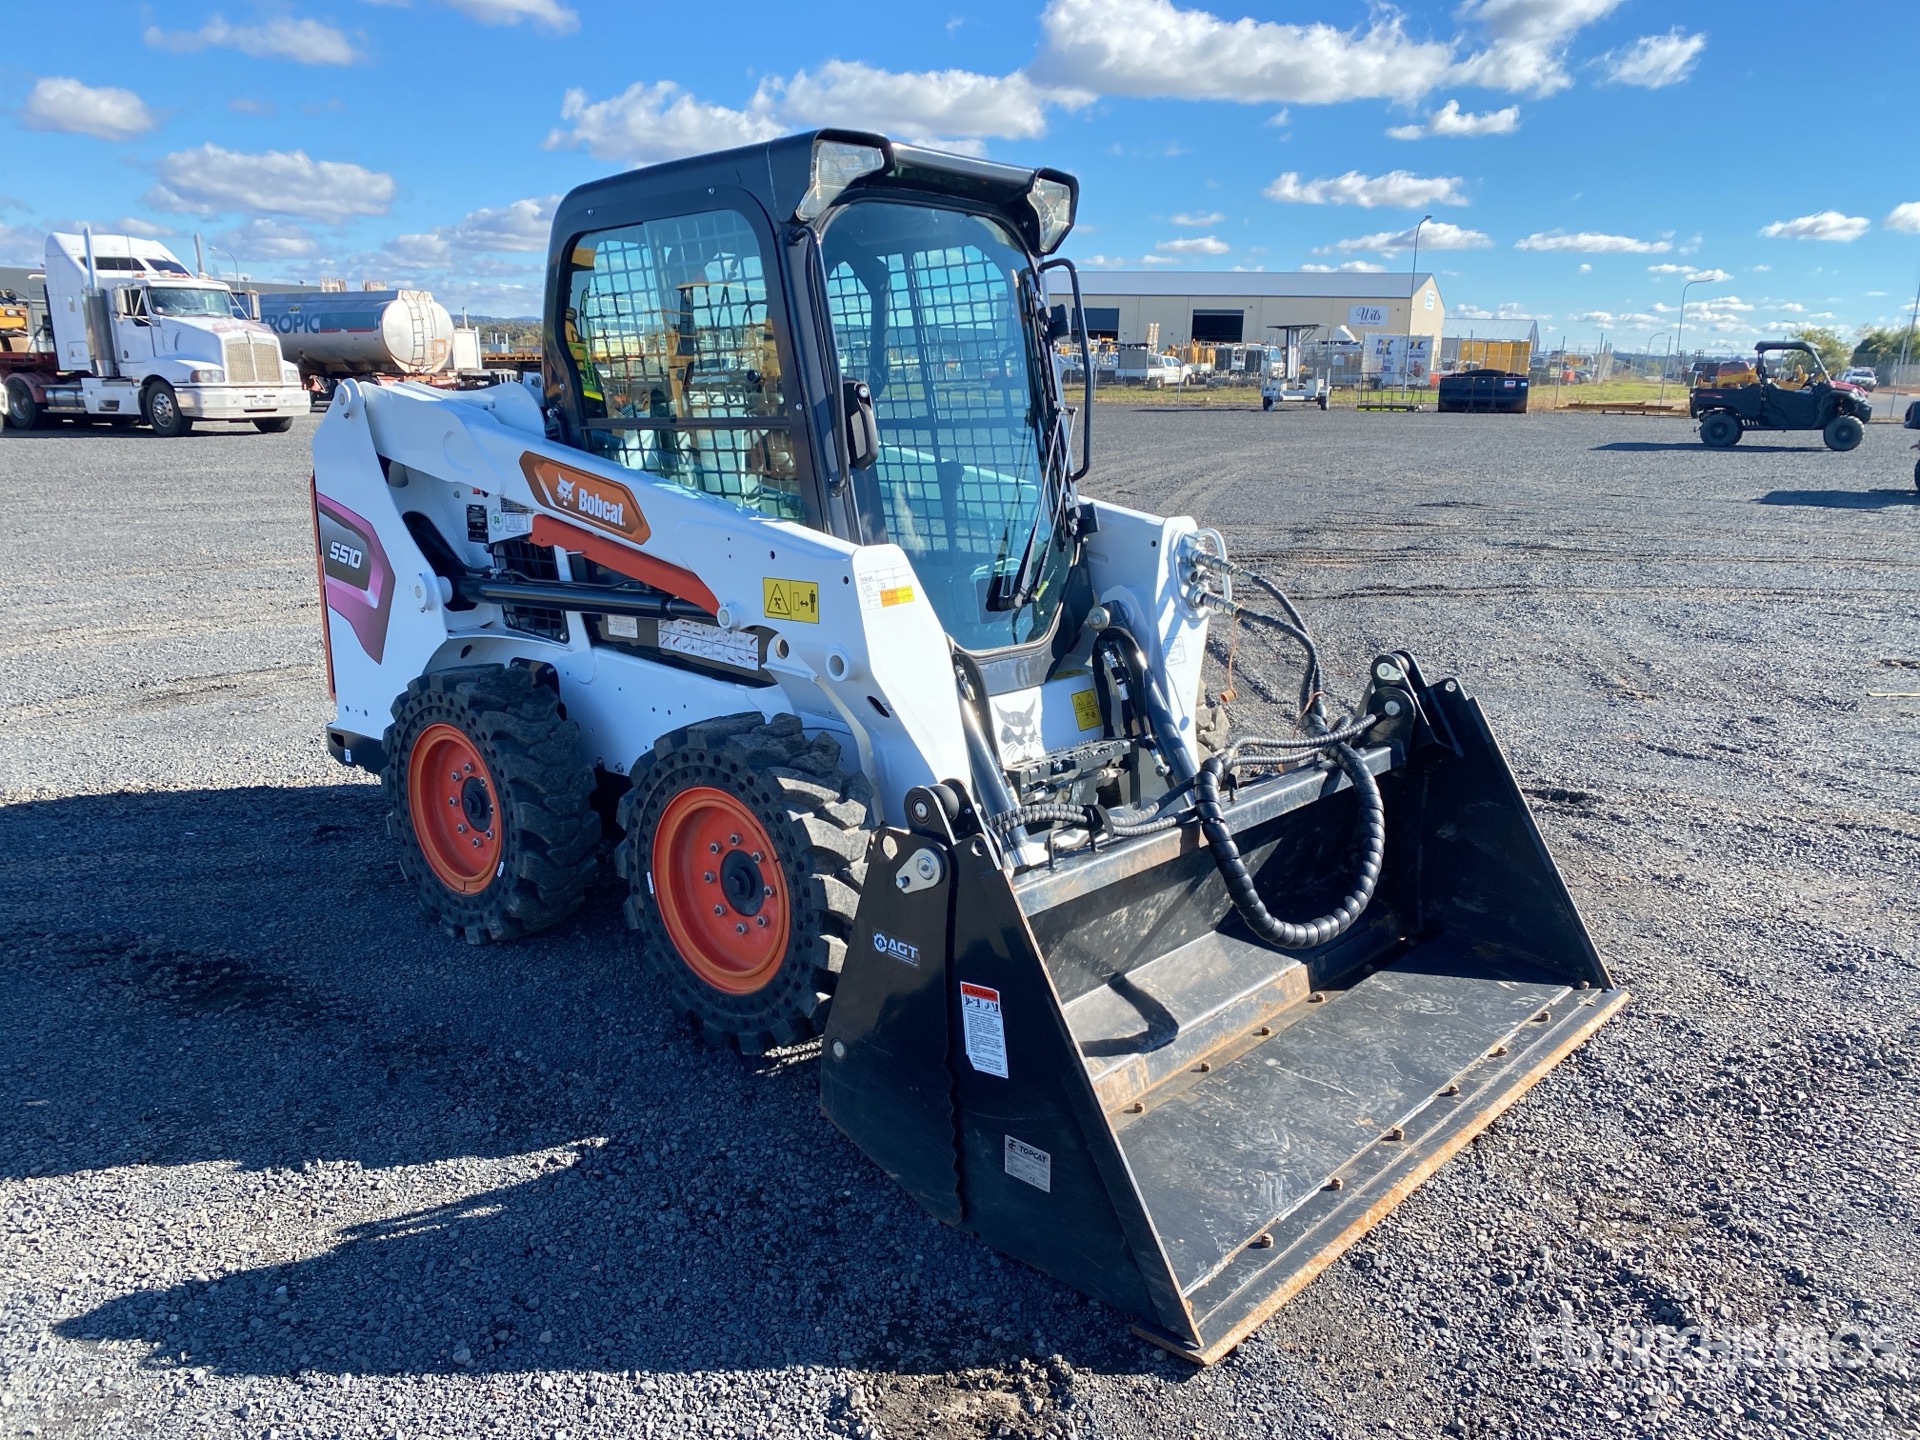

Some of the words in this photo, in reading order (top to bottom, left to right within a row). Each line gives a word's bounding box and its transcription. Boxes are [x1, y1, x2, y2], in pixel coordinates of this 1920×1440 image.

[1356, 306, 1381, 321] Wils
[578, 487, 624, 527] Bobcat
[329, 541, 363, 569] S510
[887, 938, 919, 959] AGT
[1019, 1145, 1047, 1163] TOPCAT
